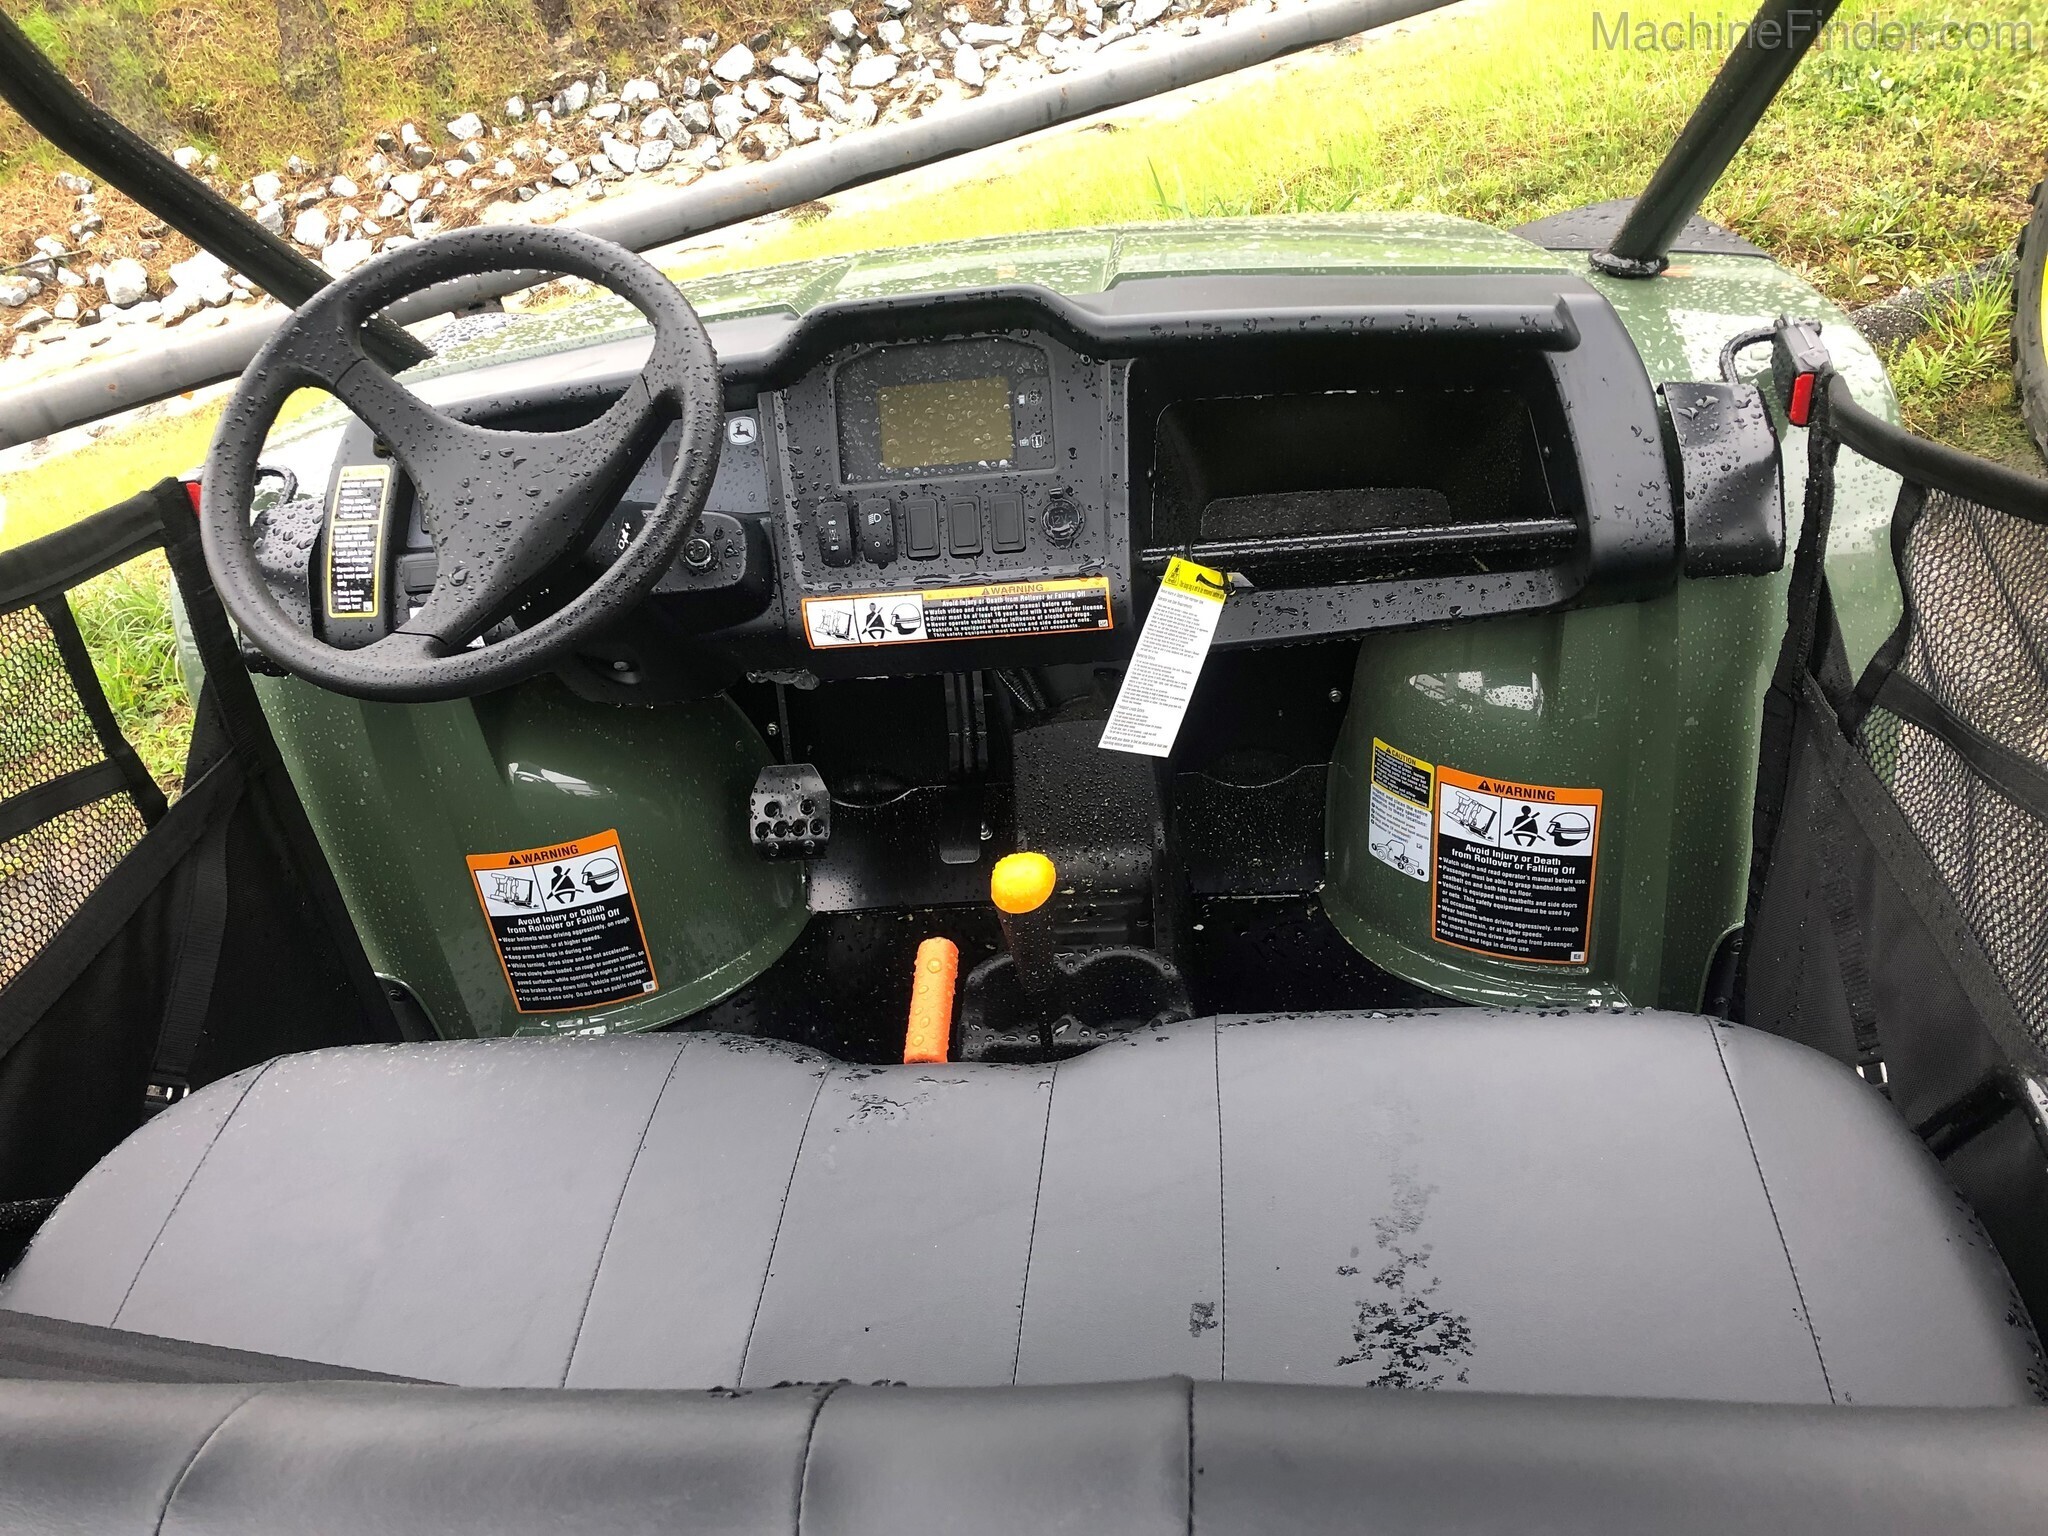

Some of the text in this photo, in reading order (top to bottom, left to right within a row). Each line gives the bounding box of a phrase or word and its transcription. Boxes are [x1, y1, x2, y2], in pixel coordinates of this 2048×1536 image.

[990, 584, 1044, 595] WARNING
[1391, 749, 1417, 766] CAUTION
[1493, 783, 1556, 801] WARNING
[521, 844, 579, 865] WARNING
[1451, 848, 1471, 860] from
[1474, 853, 1512, 868] Rollover
[1526, 863, 1558, 875] Falling
[1561, 866, 1575, 874] Off
[1465, 843, 1489, 855] Avoid
[1492, 849, 1518, 862] Injury
[1533, 855, 1560, 865] Death
[1442, 856, 1459, 866] Watch
[1460, 862, 1475, 870] video
[1501, 871, 1530, 880] operator's
[1442, 865, 1470, 877] Passenger
[1532, 883, 1561, 891] handholds
[1442, 874, 1463, 883] seatbelt
[1442, 881, 1461, 891] Vehicle
[1468, 889, 1494, 899] equipped
[1508, 897, 1534, 905] seatbelts
[1463, 894, 1474, 902] This
[1475, 899, 1492, 907] safety
[1493, 902, 1523, 911] equipment
[517, 916, 540, 925] Avoid
[542, 914, 566, 923] Injury
[579, 904, 604, 916] Death
[527, 922, 563, 932] Rollover
[576, 913, 606, 925] Falling
[607, 908, 619, 917] Off
[1441, 904, 1455, 913] Wear
[1456, 909, 1477, 919] helmets
[1494, 918, 1513, 927] driving
[1447, 915, 1466, 924] uneven
[1502, 927, 1520, 935] higher
[1449, 923, 1462, 931] more
[1440, 928, 1454, 937] Keep
[1480, 938, 1492, 946] legs
[1499, 943, 1517, 951] during
